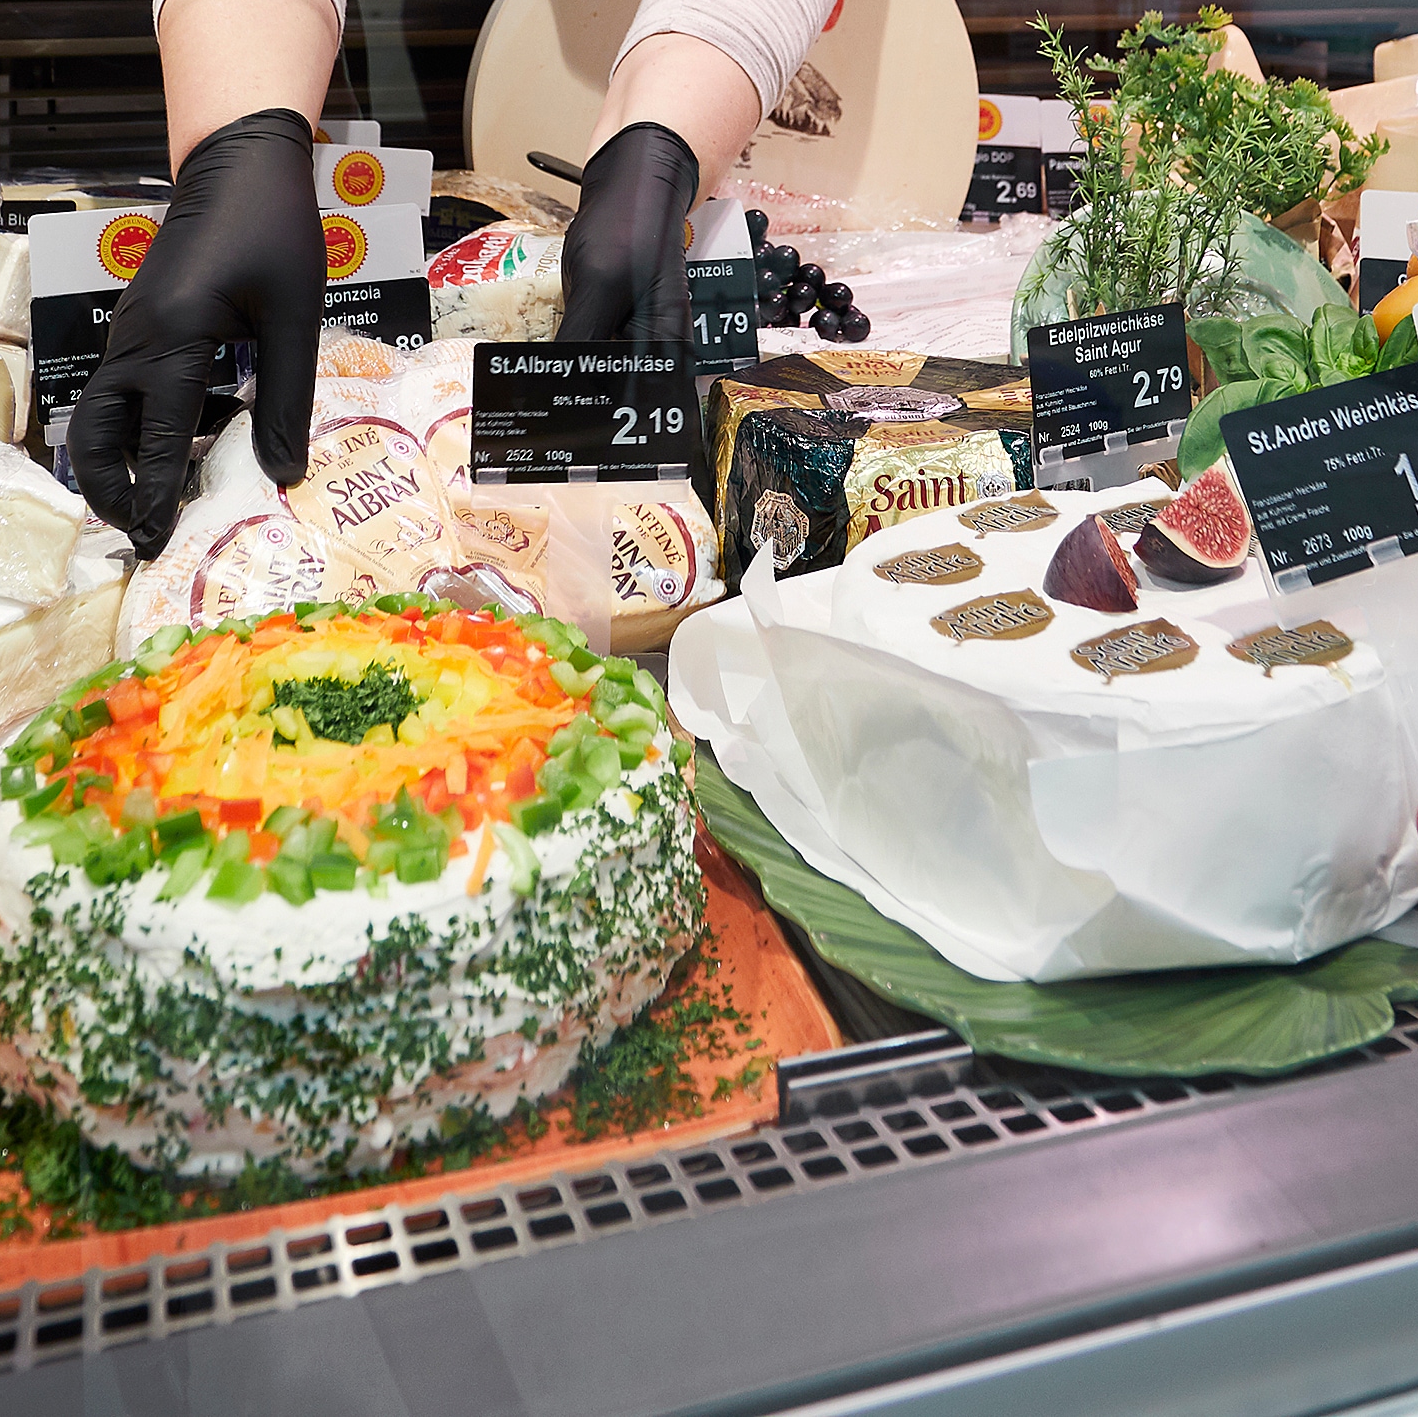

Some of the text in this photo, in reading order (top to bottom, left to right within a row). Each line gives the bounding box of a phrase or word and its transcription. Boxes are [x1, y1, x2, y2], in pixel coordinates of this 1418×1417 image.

[996, 180, 1037, 203] 2.69
[693, 312, 749, 345] 1.79
[1049, 313, 1165, 346] Edelpilzweichkäse
[490, 355, 675, 378] St.Albray Weichkäse
[1075, 339, 1142, 364] Saint Agur
[1090, 369, 1104, 379] 60%
[1105, 366, 1117, 376] Fett
[1133, 365, 1183, 408] 2.79
[41, 393, 58, 406] Nr.
[611, 406, 683, 445] 2.19
[1038, 420, 1108, 444] Nr. 2524 100g
[1247, 416, 1331, 455] St.Andre
[475, 449, 573, 462] Nr. 2522 100g
[1323, 458, 1346, 472] 75%
[1346, 452, 1366, 466] Fett
[326, 456, 397, 505] SAINT
[870, 468, 969, 513] Saint
[331, 468, 423, 534] ALBRAY
[1270, 525, 1374, 567] Nr. 2673 100g
